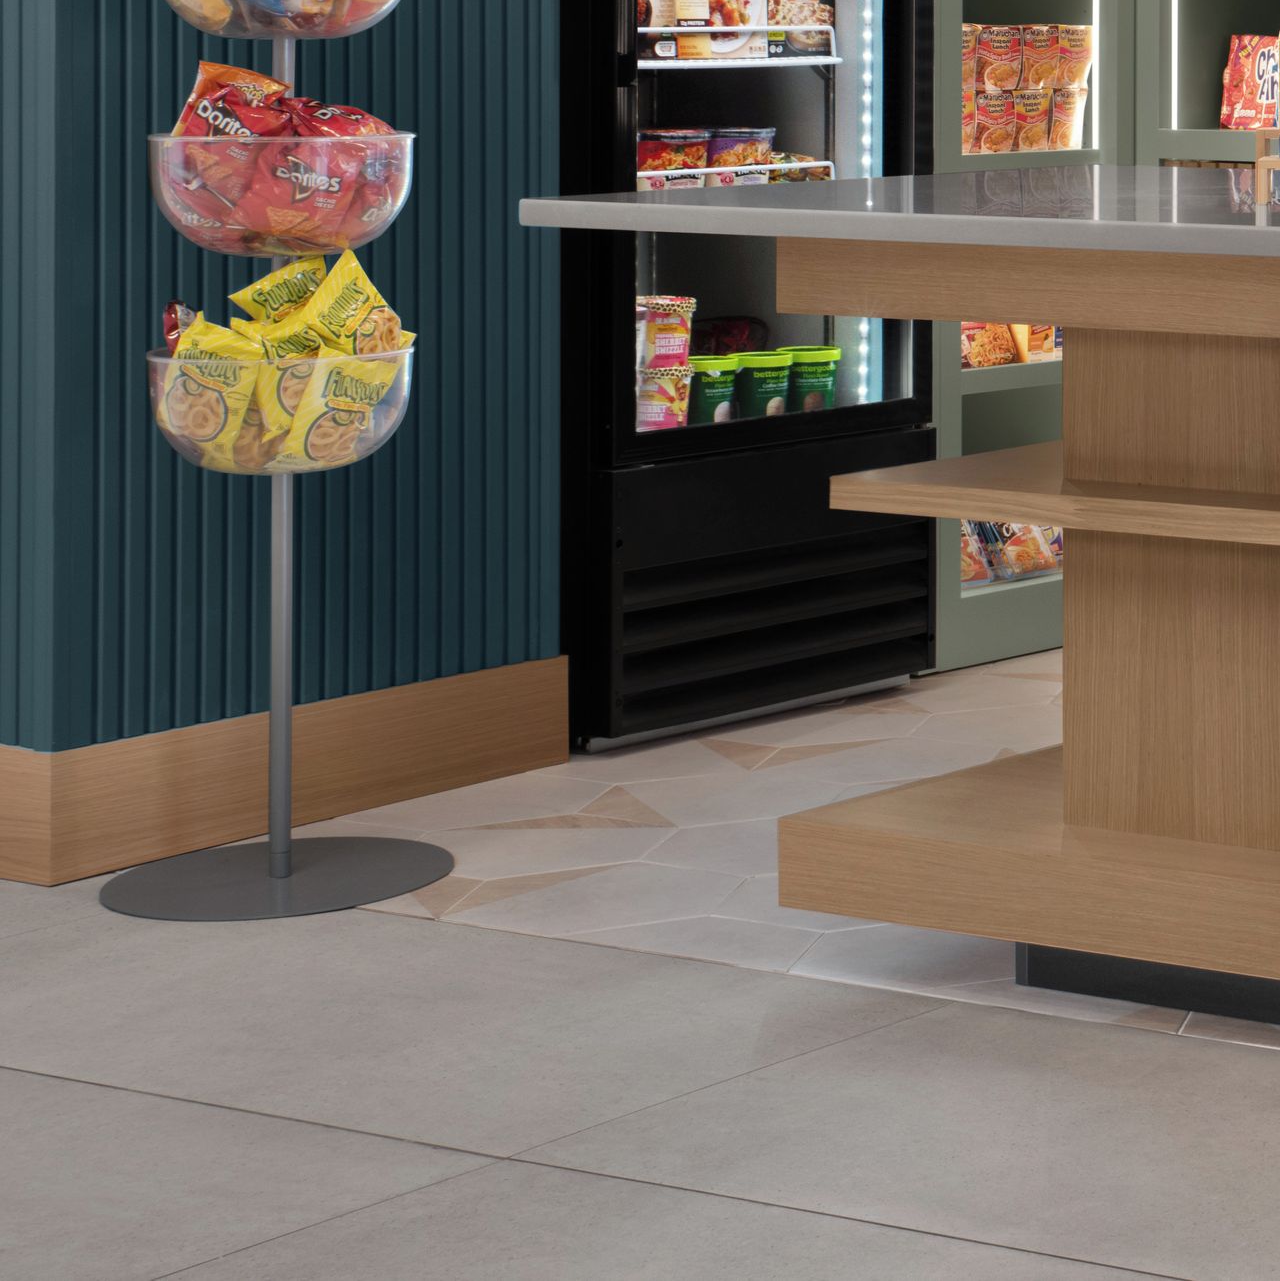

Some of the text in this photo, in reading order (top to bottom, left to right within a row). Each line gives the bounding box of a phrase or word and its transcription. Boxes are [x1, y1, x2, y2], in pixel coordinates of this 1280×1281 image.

[988, 29, 1020, 38] Maruchan
[1031, 29, 1058, 37] Maruchan
[983, 93, 1011, 101] Maruchan
[1021, 92, 1048, 100] Maruchan
[274, 167, 341, 192] Doritos
